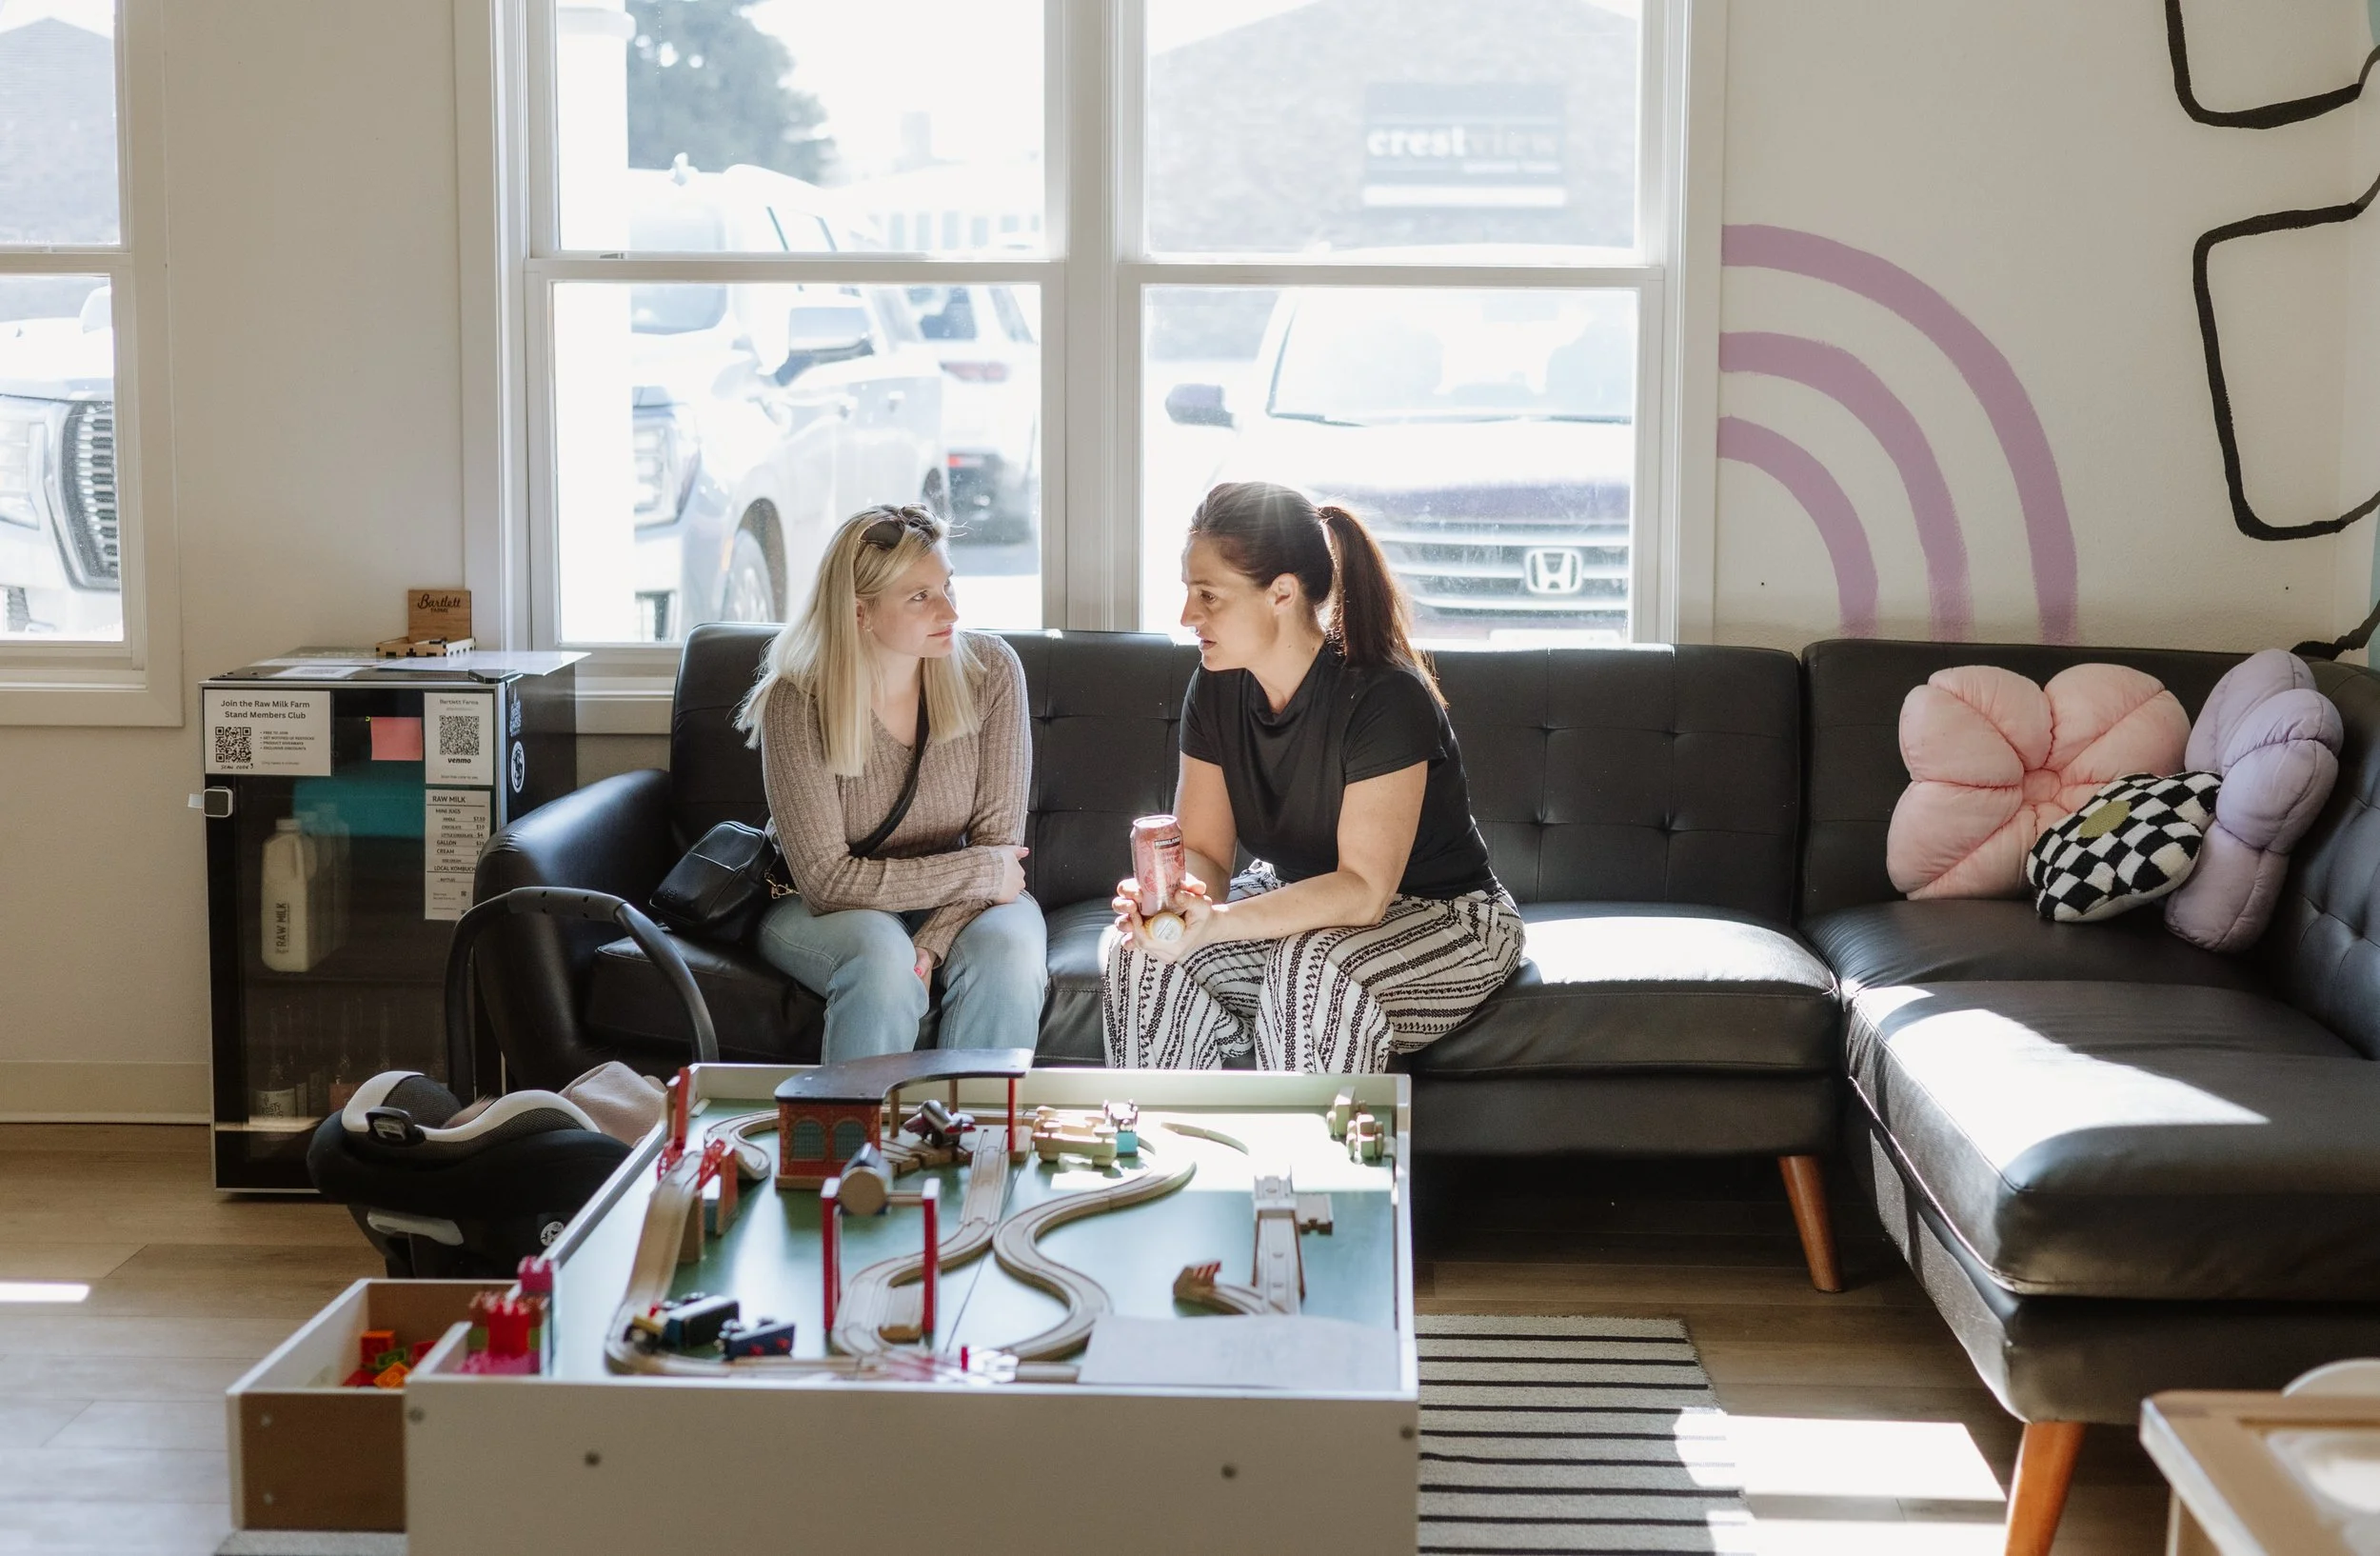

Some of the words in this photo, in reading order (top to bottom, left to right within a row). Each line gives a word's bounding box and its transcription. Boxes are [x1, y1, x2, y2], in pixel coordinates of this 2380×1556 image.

[417, 592, 461, 609] Bartlett
[271, 700, 288, 708] Milk
[289, 700, 310, 708] Farm
[275, 902, 287, 923] MILK
[275, 925, 287, 948] RAW
